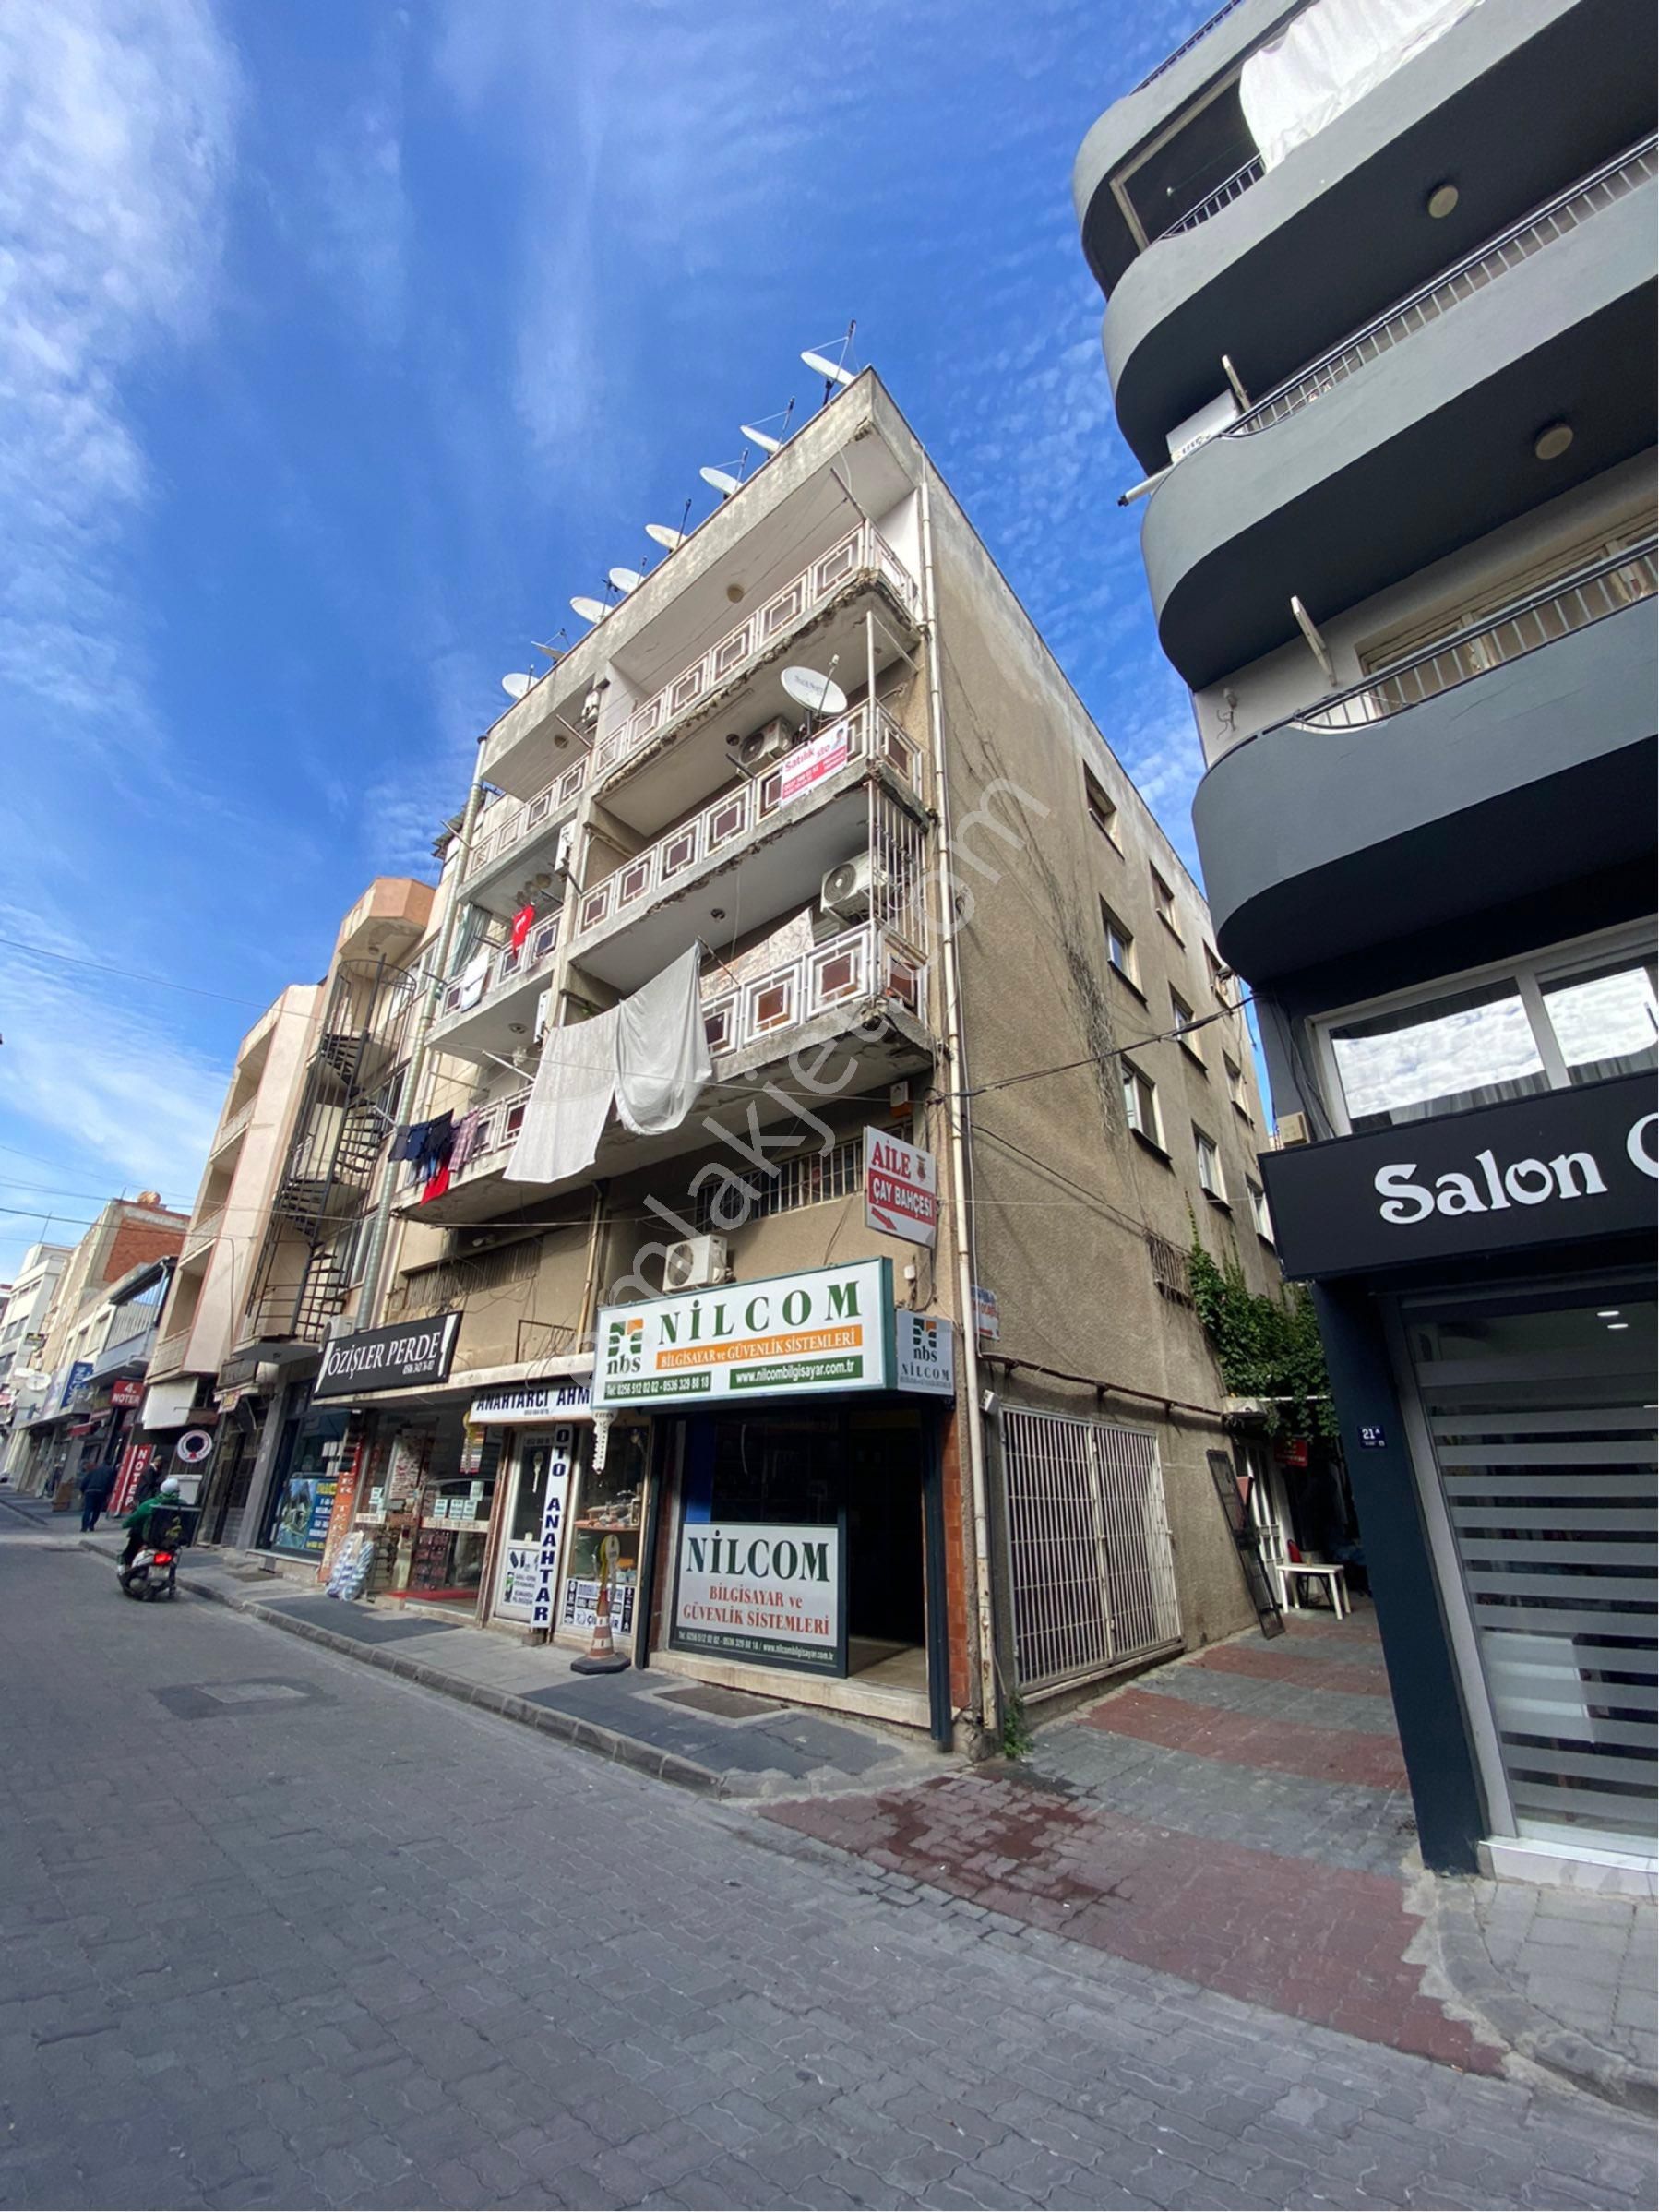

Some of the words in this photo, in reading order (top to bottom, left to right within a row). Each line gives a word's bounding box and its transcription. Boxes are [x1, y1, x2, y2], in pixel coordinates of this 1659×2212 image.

[871, 1139, 911, 1179] AİLE
[873, 1178, 892, 1204] ÇAY
[1374, 1149, 1608, 1225] Salon
[659, 1281, 861, 1345] NİLCOM
[328, 1343, 385, 1379] ÖZİŞLER
[386, 1332, 441, 1366] PERDE
[607, 1354, 641, 1374] nbs
[661, 1348, 715, 1368] BİLGİSAYAR
[717, 1352, 726, 1360] ve
[727, 1338, 784, 1360] GÜVENLİK
[785, 1327, 856, 1352] SİSTEMLERİ
[913, 1345, 937, 1362] nbs
[736, 1359, 855, 1382] www.nilcombilgisayar.com.tr
[901, 1362, 949, 1381] NİLCOM
[113, 1393, 141, 1405] NOTER
[476, 1388, 549, 1411] ANAHTARCI
[552, 1429, 570, 1477] OTO
[533, 1497, 561, 1621] ANAHTAR
[686, 1530, 830, 1582] NİLCOM
[709, 1582, 783, 1608] BİLGİSAYAR
[789, 1596, 803, 1609] ve
[683, 1601, 743, 1625] GÜVENLİK
[747, 1608, 830, 1635] SİSTEMLERİ
